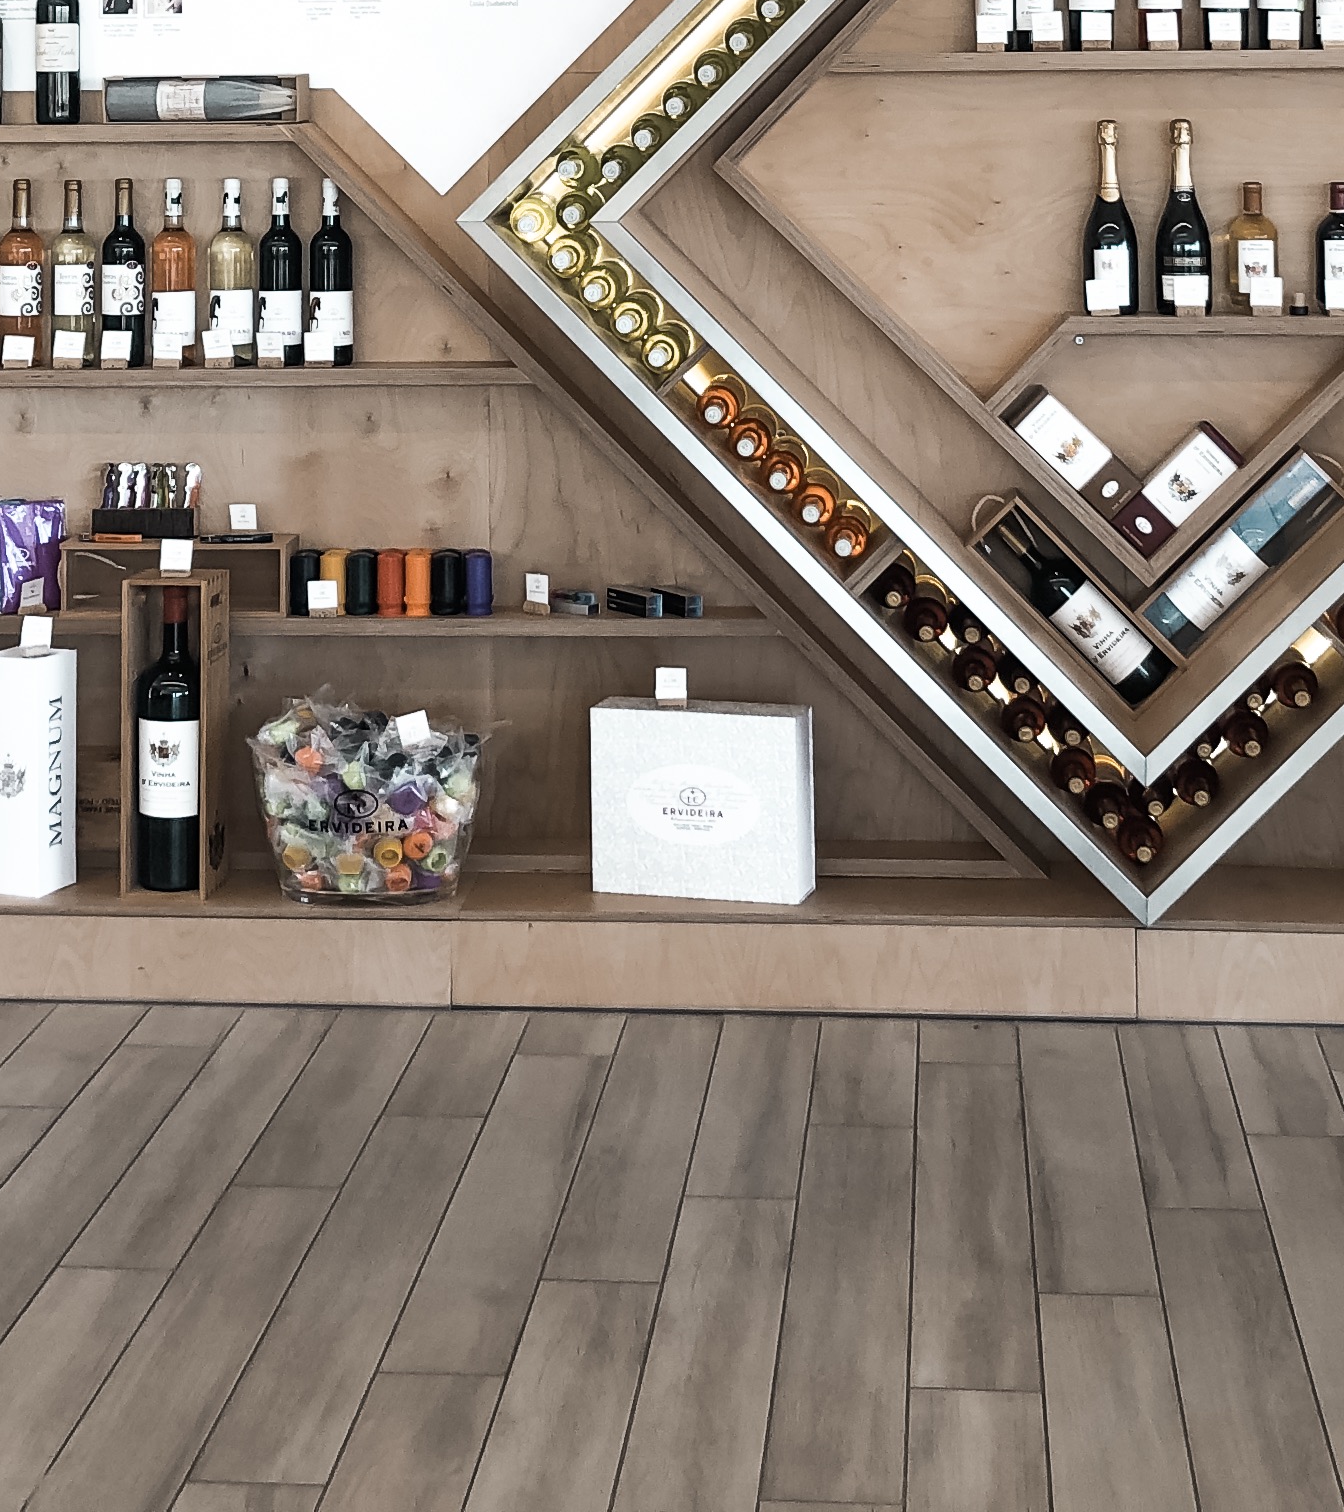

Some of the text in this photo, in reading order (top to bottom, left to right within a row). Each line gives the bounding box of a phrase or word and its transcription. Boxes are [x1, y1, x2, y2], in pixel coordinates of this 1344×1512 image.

[1092, 629, 1116, 652] VINHA
[1097, 626, 1131, 658] ERVIDEIRA
[48, 695, 63, 849] MAGNUM
[151, 770, 176, 778] VINHA
[148, 779, 191, 788] ERVIDEIRA
[662, 807, 724, 818] ERVIDEIRA
[308, 818, 409, 834] ERVIDEIRA
